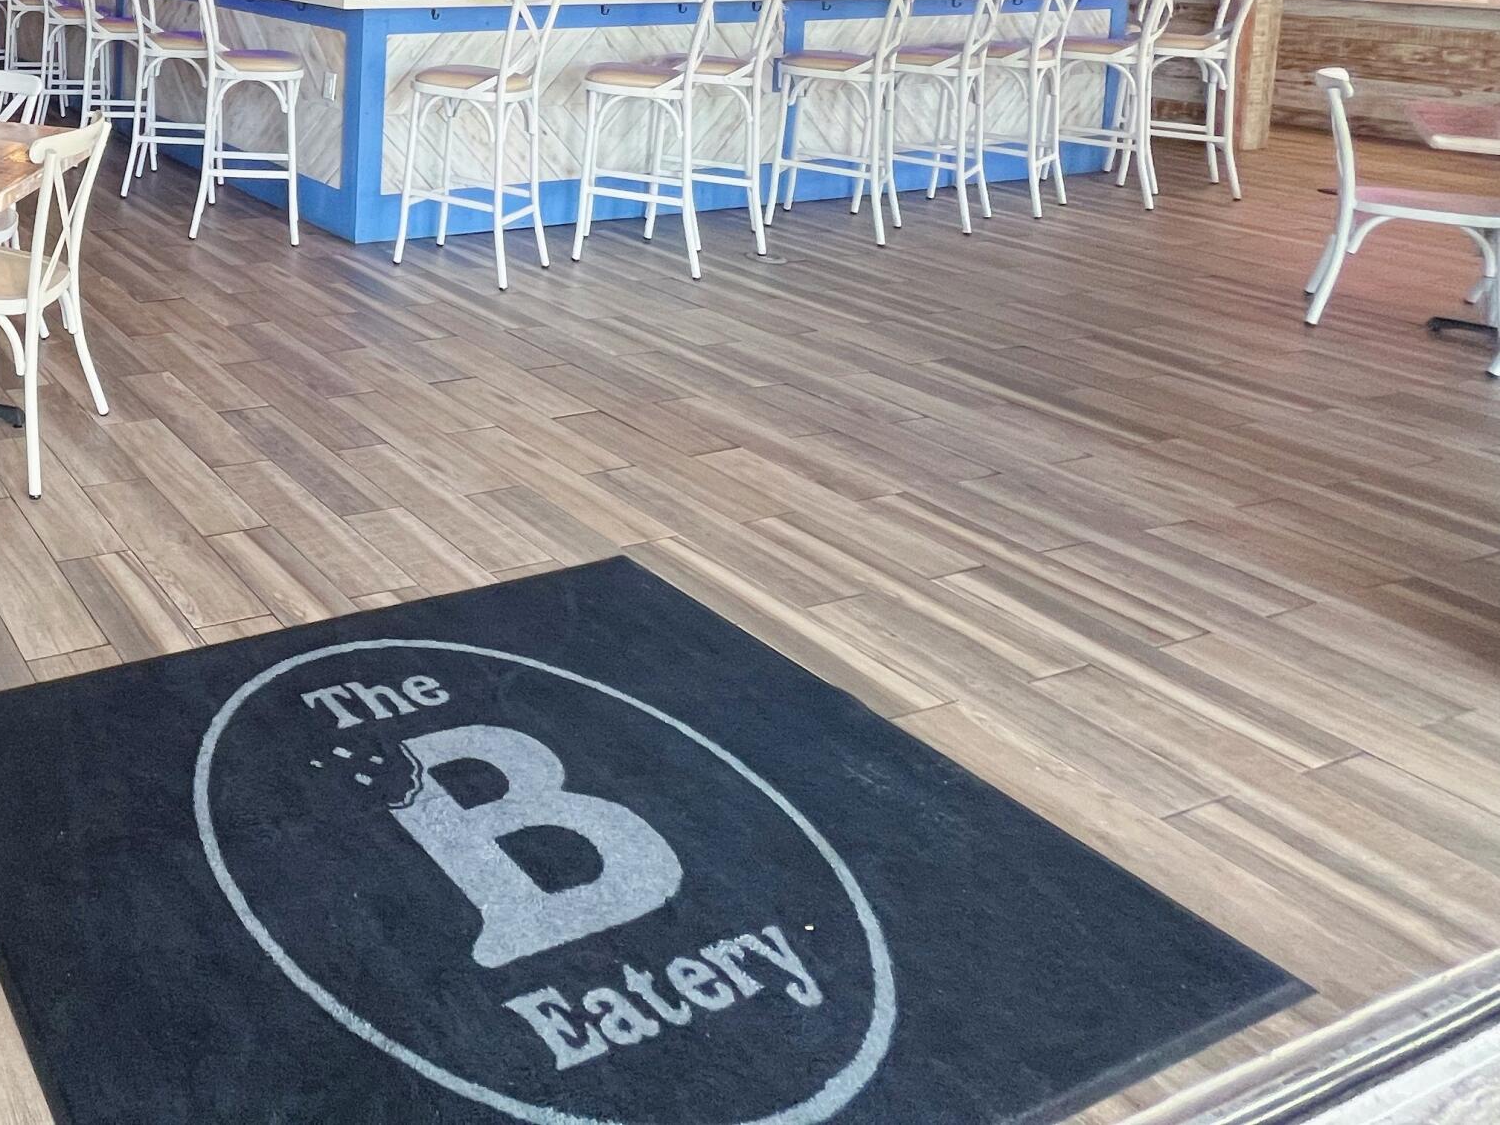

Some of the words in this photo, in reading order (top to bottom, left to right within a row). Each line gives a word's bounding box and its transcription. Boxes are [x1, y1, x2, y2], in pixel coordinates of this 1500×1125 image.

[301, 670, 451, 730] The
[389, 724, 683, 968] B
[504, 923, 824, 1071] Eatery
